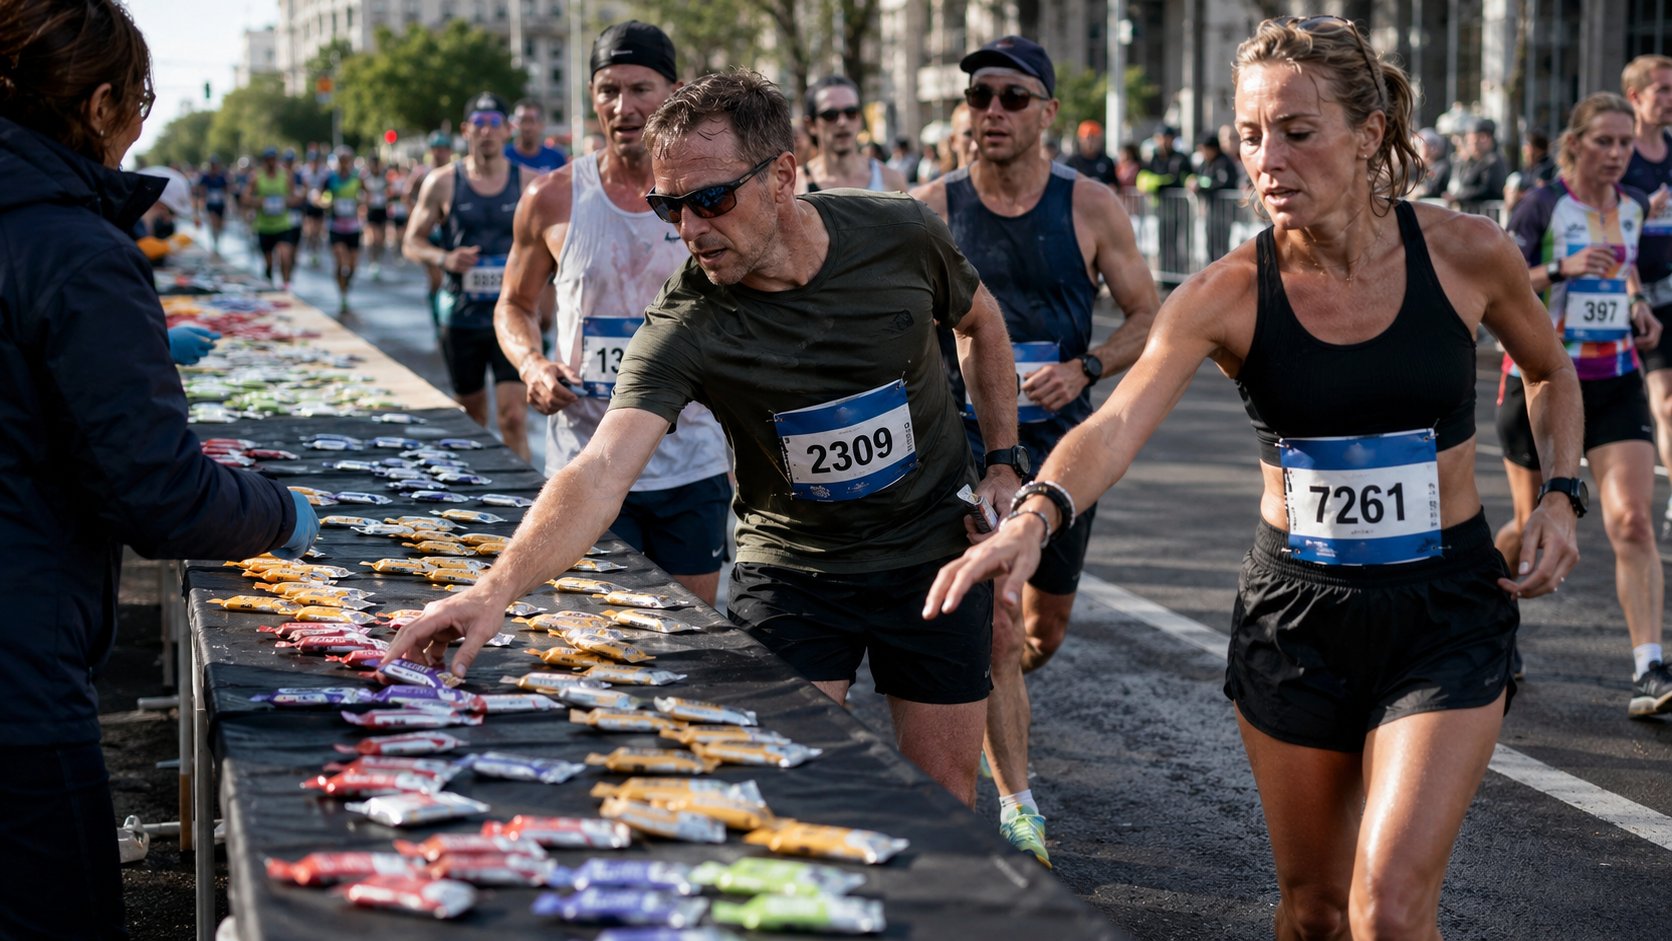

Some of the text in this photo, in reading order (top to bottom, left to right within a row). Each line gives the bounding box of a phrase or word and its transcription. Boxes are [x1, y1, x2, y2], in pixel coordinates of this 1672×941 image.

[1583, 300, 1617, 322] 397
[806, 427, 893, 474] 2309
[1309, 482, 1406, 525] 7261
